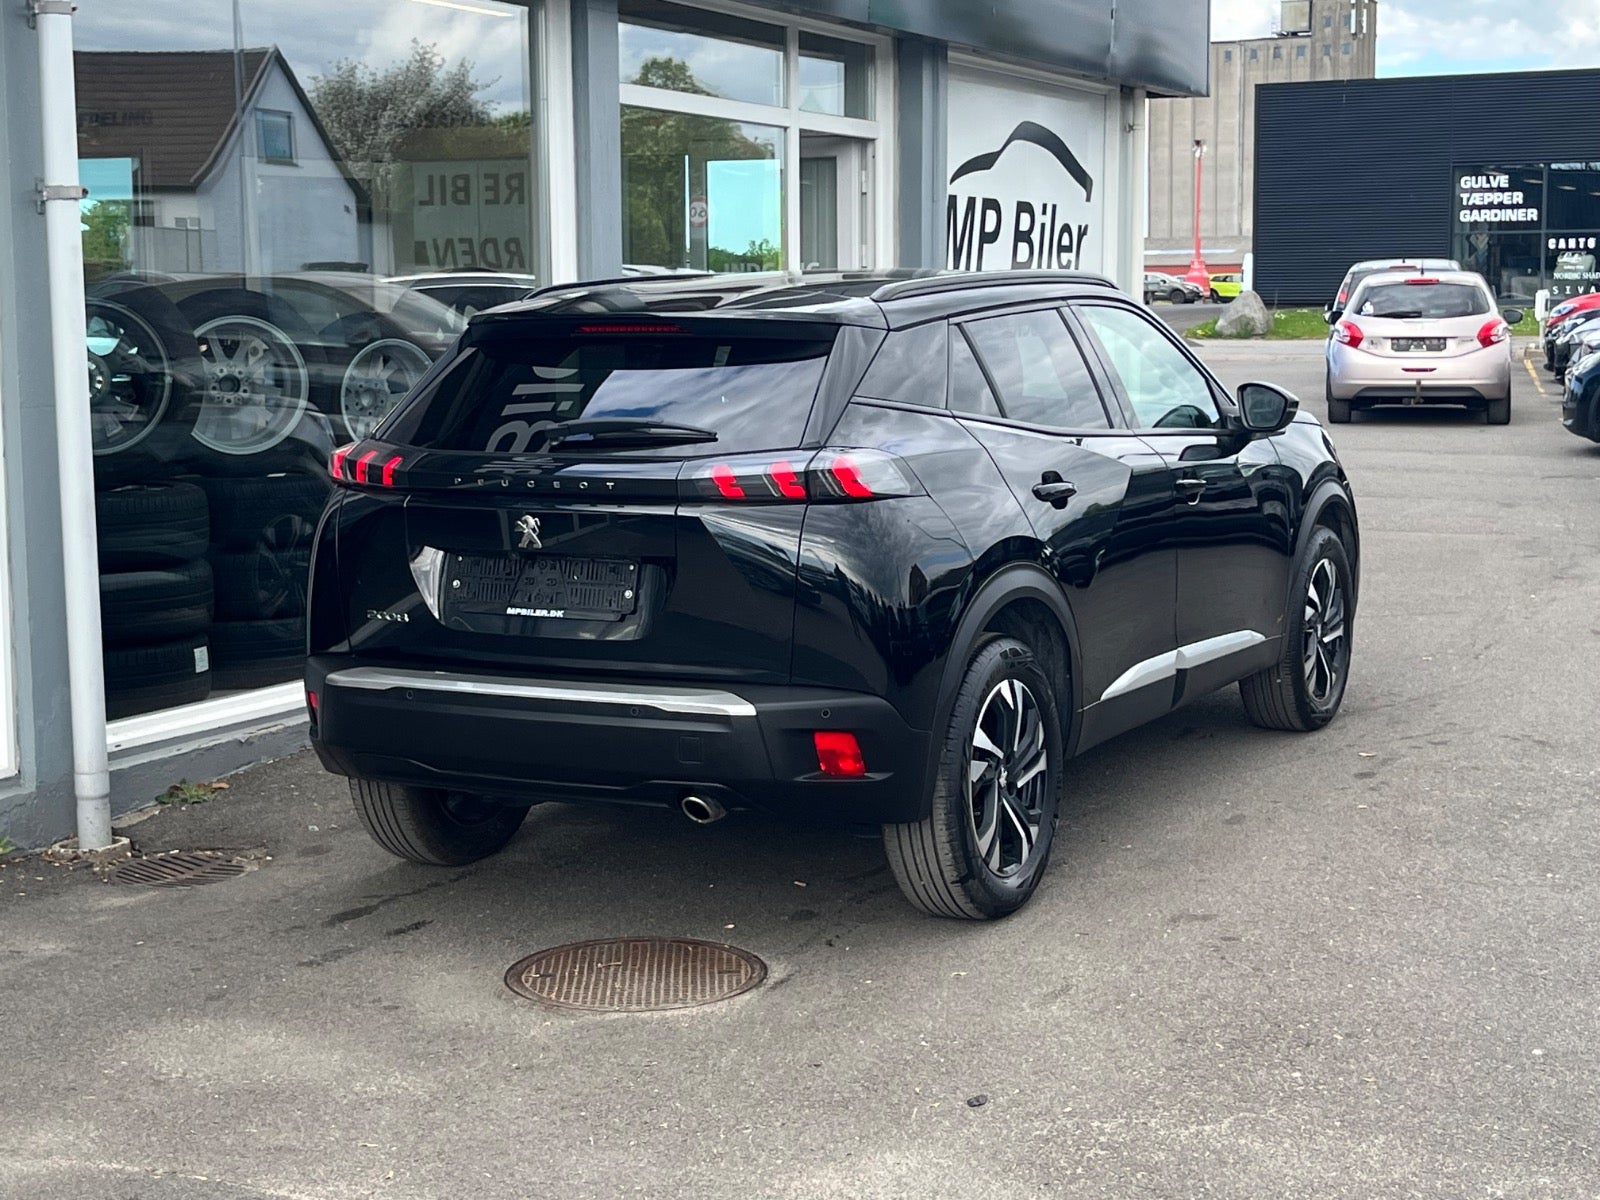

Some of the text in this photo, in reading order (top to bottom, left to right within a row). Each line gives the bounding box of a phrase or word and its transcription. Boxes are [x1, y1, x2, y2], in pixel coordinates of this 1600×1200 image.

[1460, 175, 1509, 188] GULVE
[1460, 192, 1523, 205] TÆPPER
[1460, 208, 1538, 222] GARDINER
[947, 194, 1089, 271] MP Biler
[454, 477, 615, 490] PEUGEOT
[506, 606, 564, 618] MPBILER.DK
